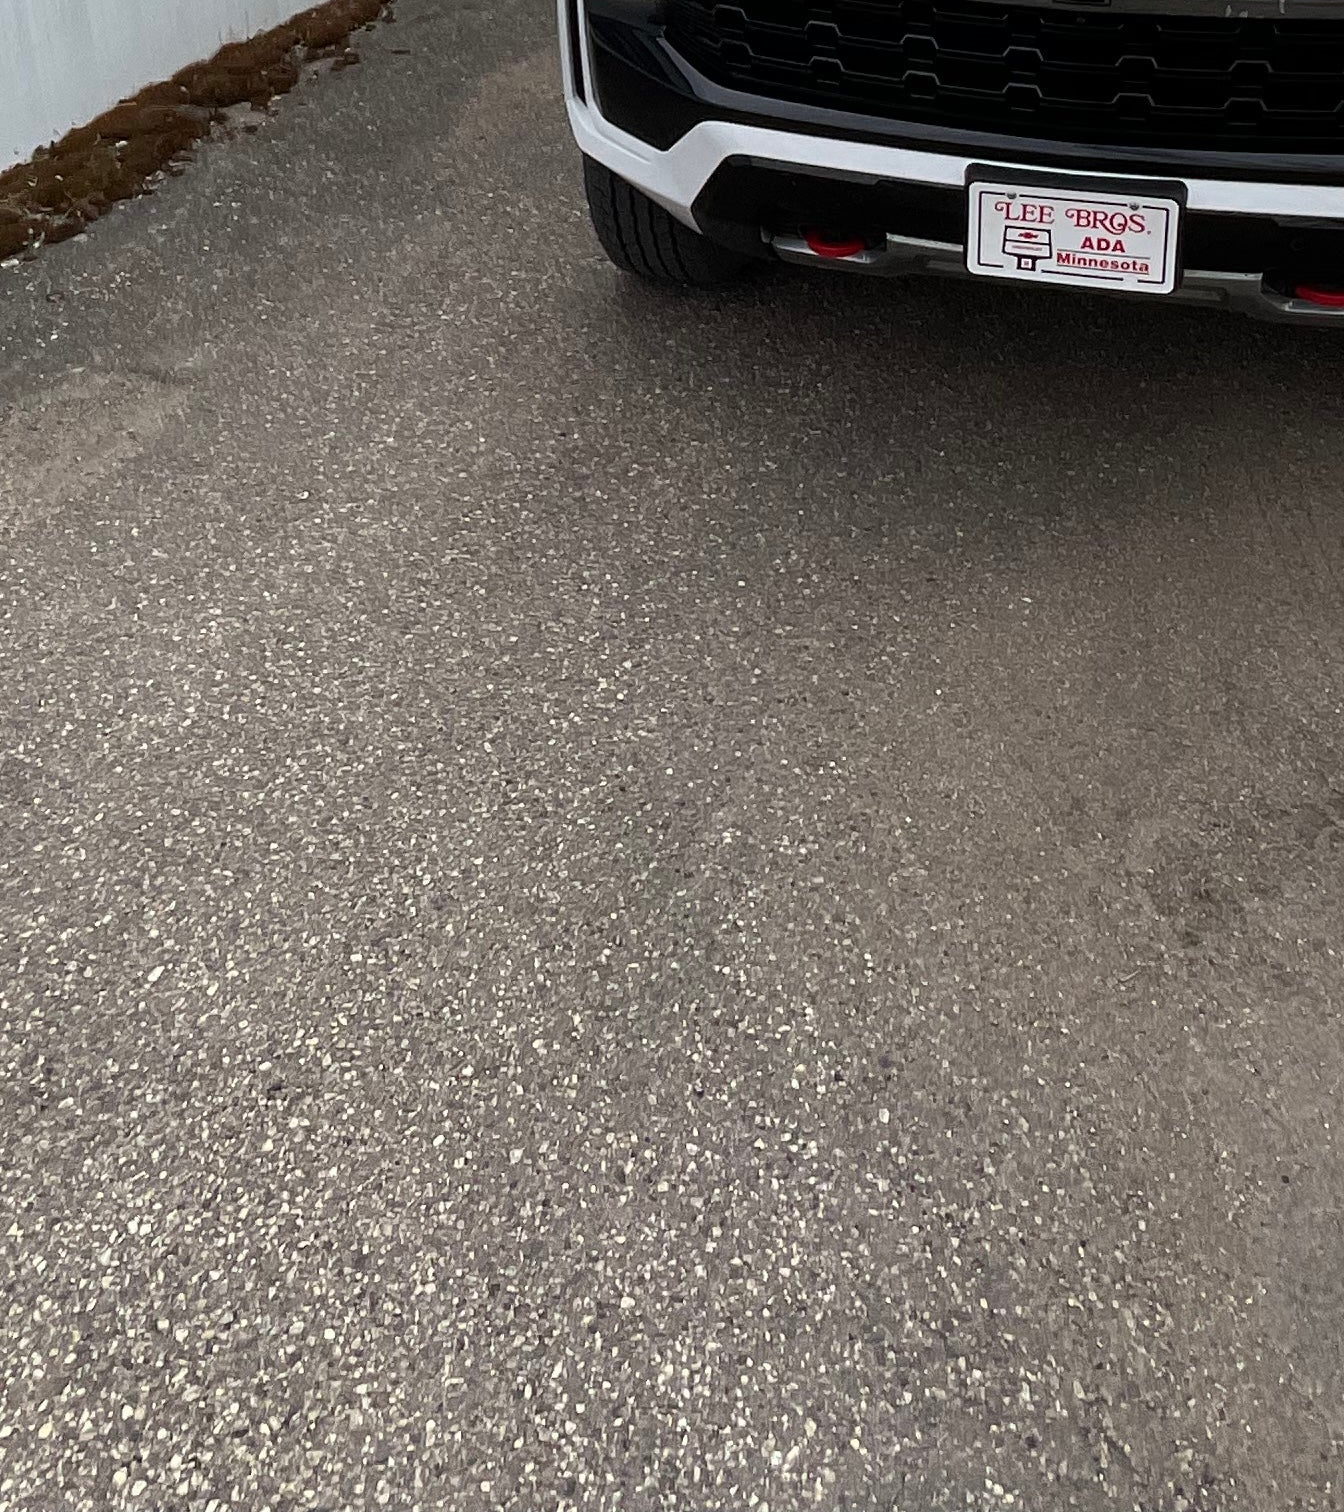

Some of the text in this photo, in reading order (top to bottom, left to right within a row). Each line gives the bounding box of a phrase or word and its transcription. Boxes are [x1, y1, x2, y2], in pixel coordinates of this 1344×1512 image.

[994, 201, 1152, 236] LEE BROS.
[1080, 236, 1126, 253] ADA
[1056, 252, 1150, 273] Minnesota
